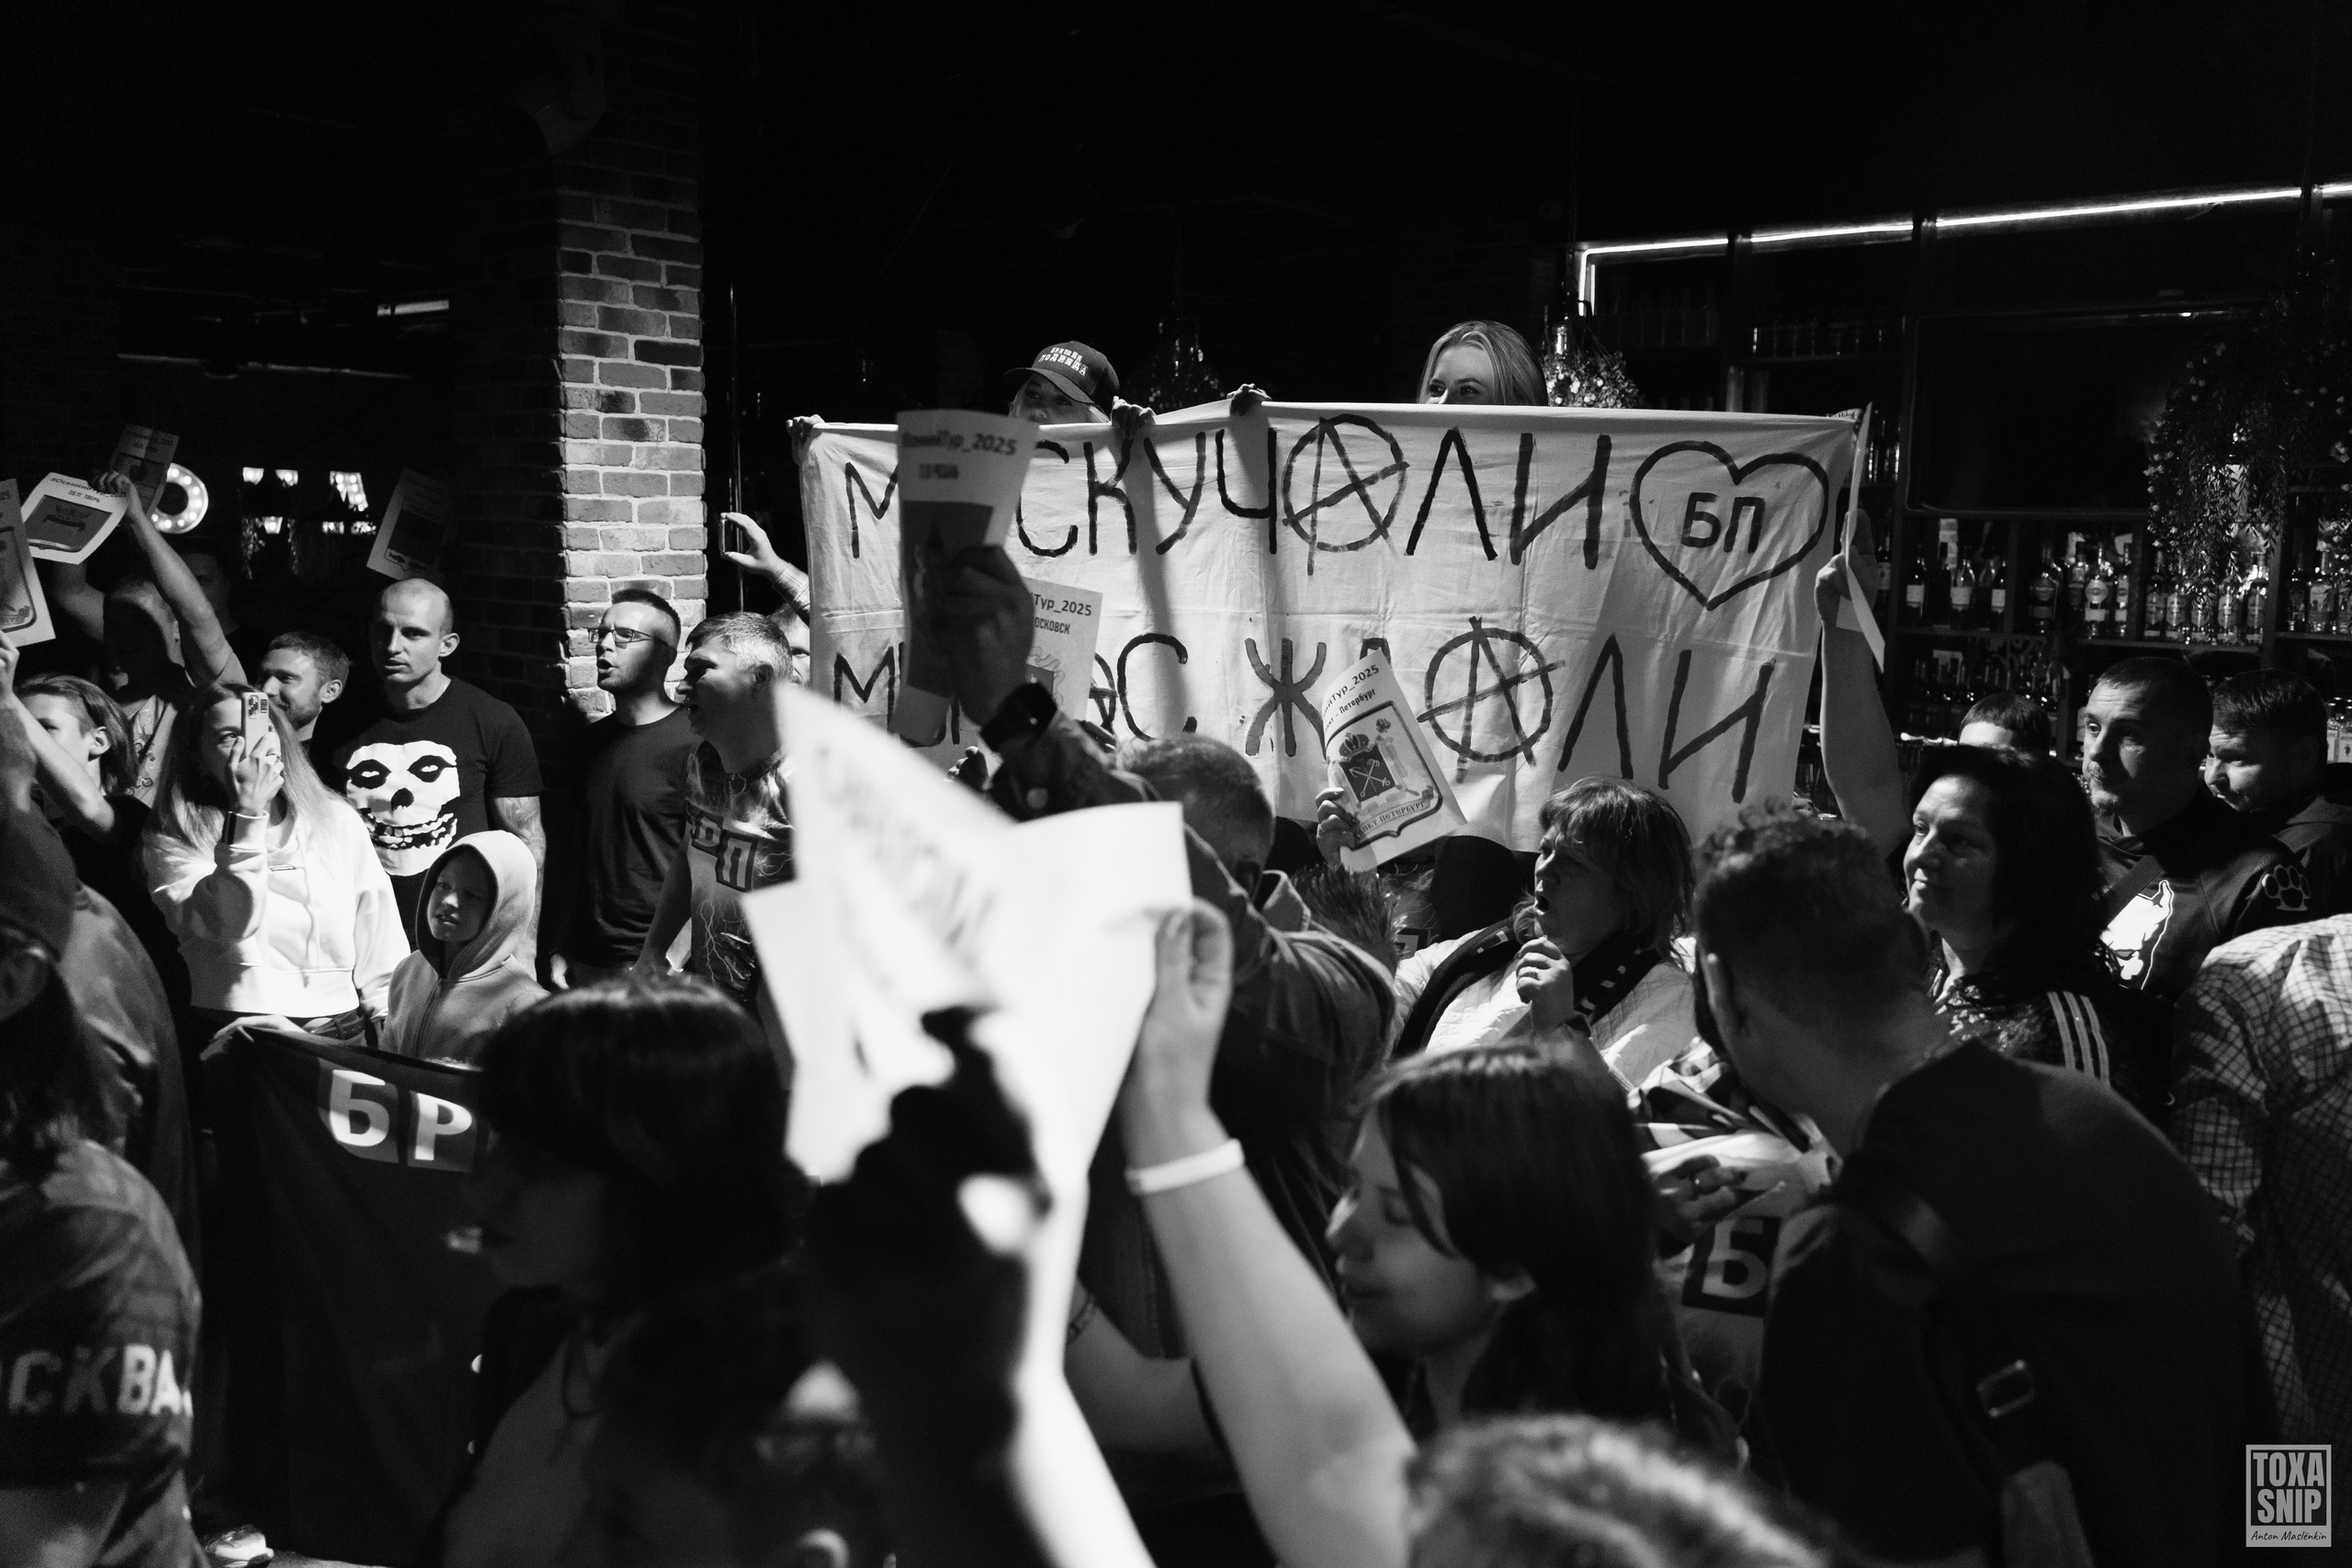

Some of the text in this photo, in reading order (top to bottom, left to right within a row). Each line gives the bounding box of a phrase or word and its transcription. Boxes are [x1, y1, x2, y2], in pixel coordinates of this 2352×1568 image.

[1016, 414, 1612, 576] СКУЧАЛИ
[1681, 492, 1765, 553] БП
[1030, 592, 1091, 616] Тур_2025
[1034, 616, 1070, 635] ОСКОВСК
[1244, 615, 1776, 804] ЖАЛИ
[1339, 688, 1376, 714] Петербург
[330, 1068, 472, 1161] БР
[0, 1343, 182, 1416] СКВА
